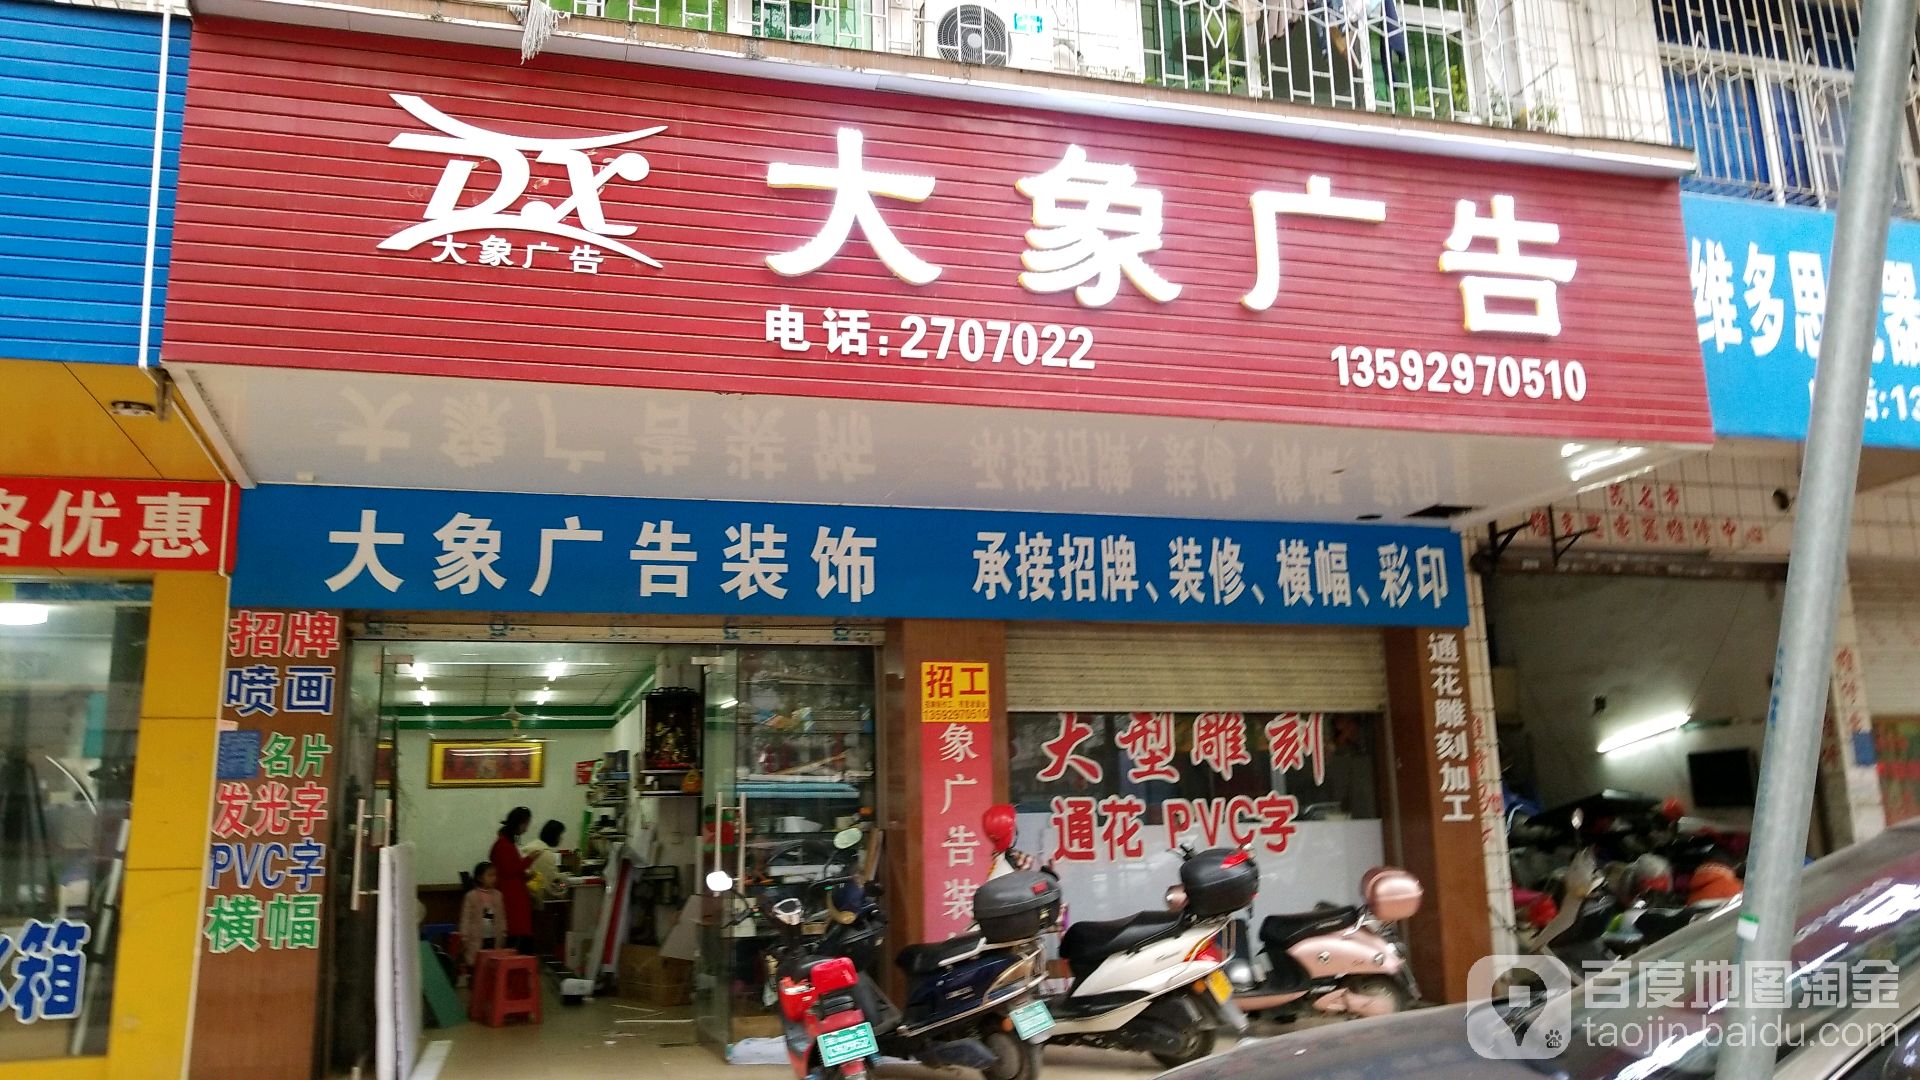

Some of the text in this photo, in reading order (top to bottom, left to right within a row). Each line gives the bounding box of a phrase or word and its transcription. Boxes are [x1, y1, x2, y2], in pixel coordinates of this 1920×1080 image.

[431, 234, 604, 275] 大象广告
[763, 127, 1576, 337] 大象广告
[1690, 236, 1920, 367] 维多思器
[764, 304, 1095, 371] 电话:2707022
[1331, 345, 1587, 402] 13592970510
[324, 509, 1450, 609] 大象广告装饰 承接招牌、装修、横幅、彩印
[228, 610, 340, 658] 招牌
[225, 665, 336, 717] 喷画
[926, 665, 987, 698] 招工
[1035, 712, 1326, 787] 大型雕刻
[1427, 632, 1475, 823] 通花雕刻加工
[212, 782, 329, 839] 发光字
[938, 722, 982, 940] 象广告装
[1049, 790, 1300, 863] 通花 PVC字
[206, 837, 326, 892] PVC字
[203, 892, 322, 954] 横幅
[0, 918, 91, 1025] 箱
